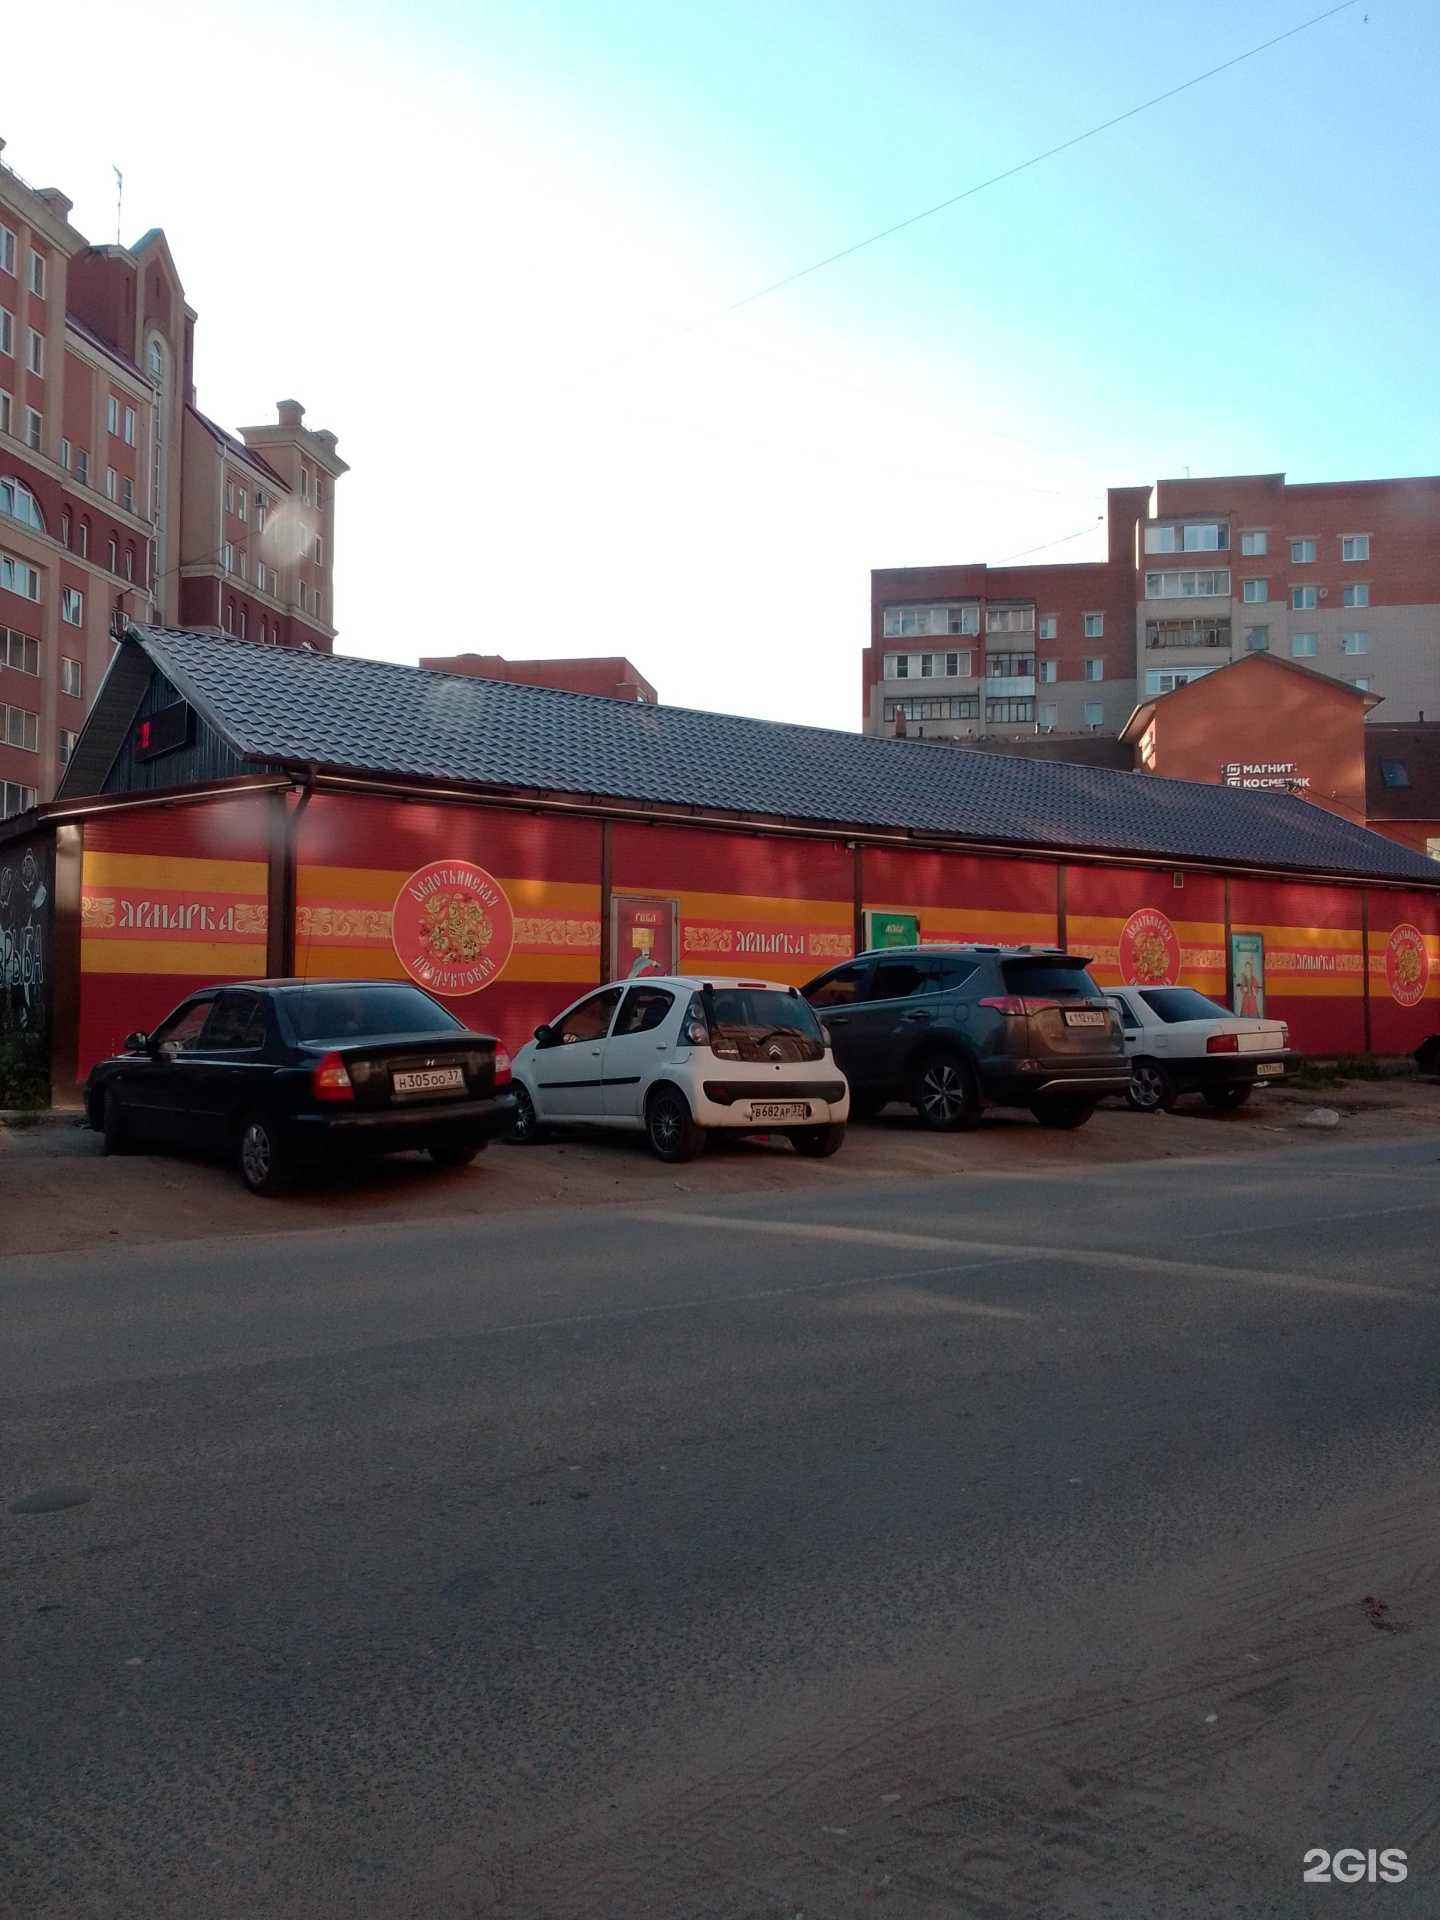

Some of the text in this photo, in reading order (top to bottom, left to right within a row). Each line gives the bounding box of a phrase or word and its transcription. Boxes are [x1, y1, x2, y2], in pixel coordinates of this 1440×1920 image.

[1243, 763, 1294, 774] МАГНИТ
[119, 899, 234, 931] ЯРМАРКА
[736, 931, 805, 954] ЯРМАРКА
